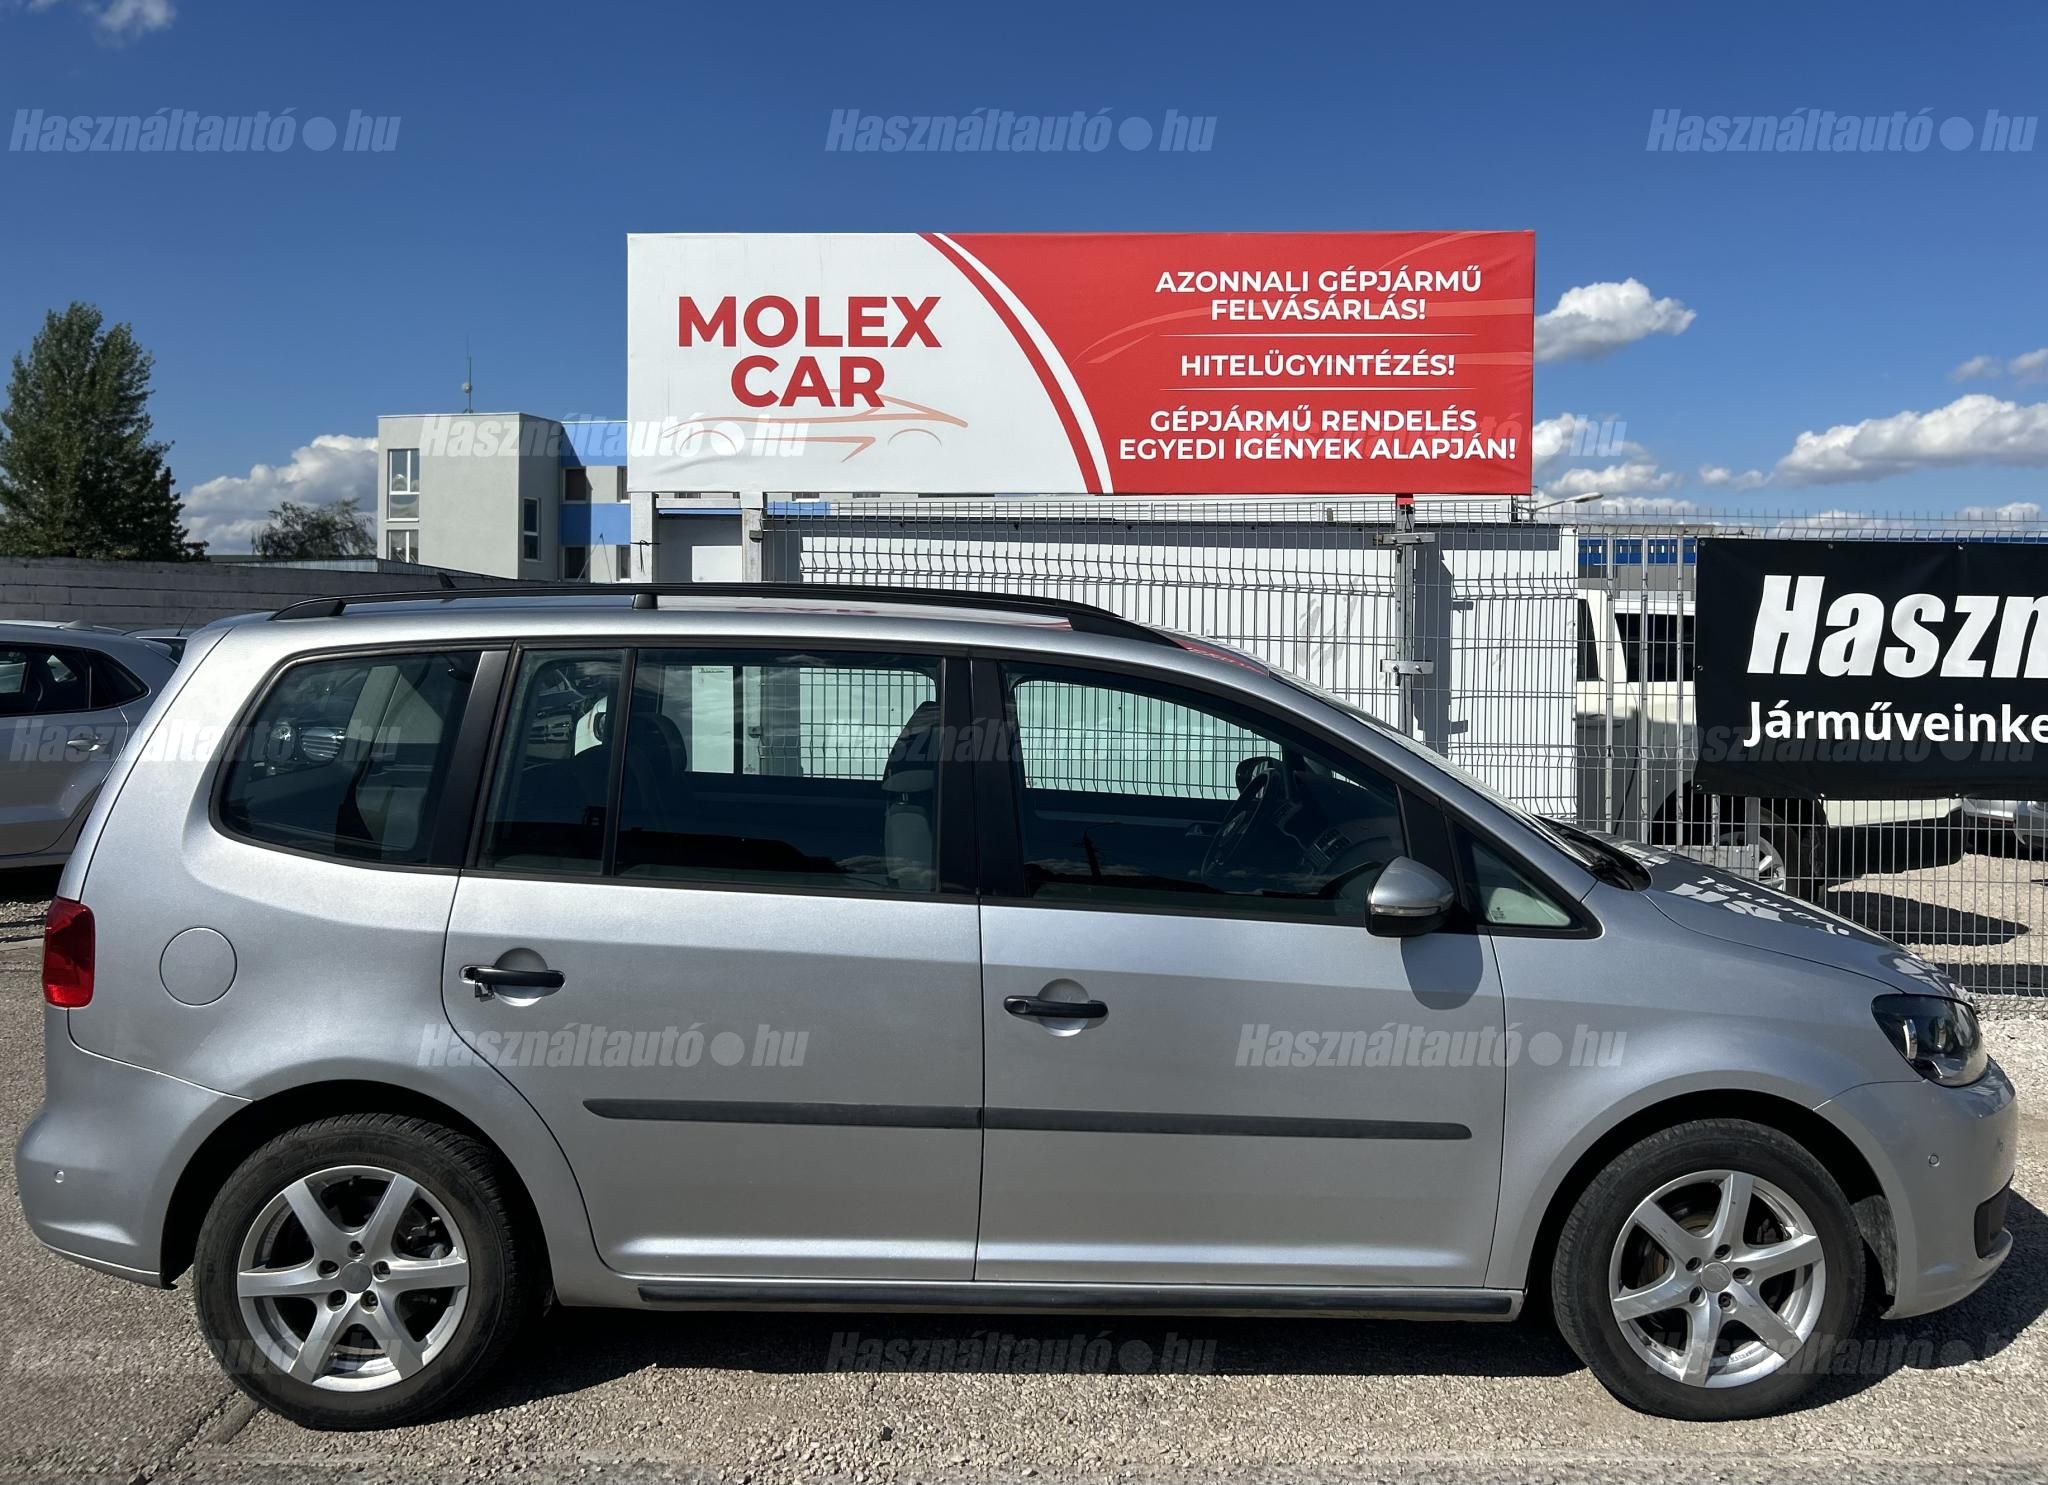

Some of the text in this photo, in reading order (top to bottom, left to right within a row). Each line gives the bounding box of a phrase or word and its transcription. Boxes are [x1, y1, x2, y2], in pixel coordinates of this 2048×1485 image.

[1155, 265, 1482, 293] AZONNALI GÉPJÁRMŰ
[1211, 293, 1426, 321] FELVÁSÁRLÁS!
[678, 295, 942, 348] MOLEX
[1181, 349, 1455, 377] HITELÜGYINTÉZÉS!
[730, 355, 886, 407] CAR
[1150, 404, 1477, 432] GÉPJÁRMŰ RENDELÉS
[1119, 432, 1517, 460] EGYEDI IGÉNYEK ALAPJÁN!
[1743, 699, 2048, 747] Járműveinke
